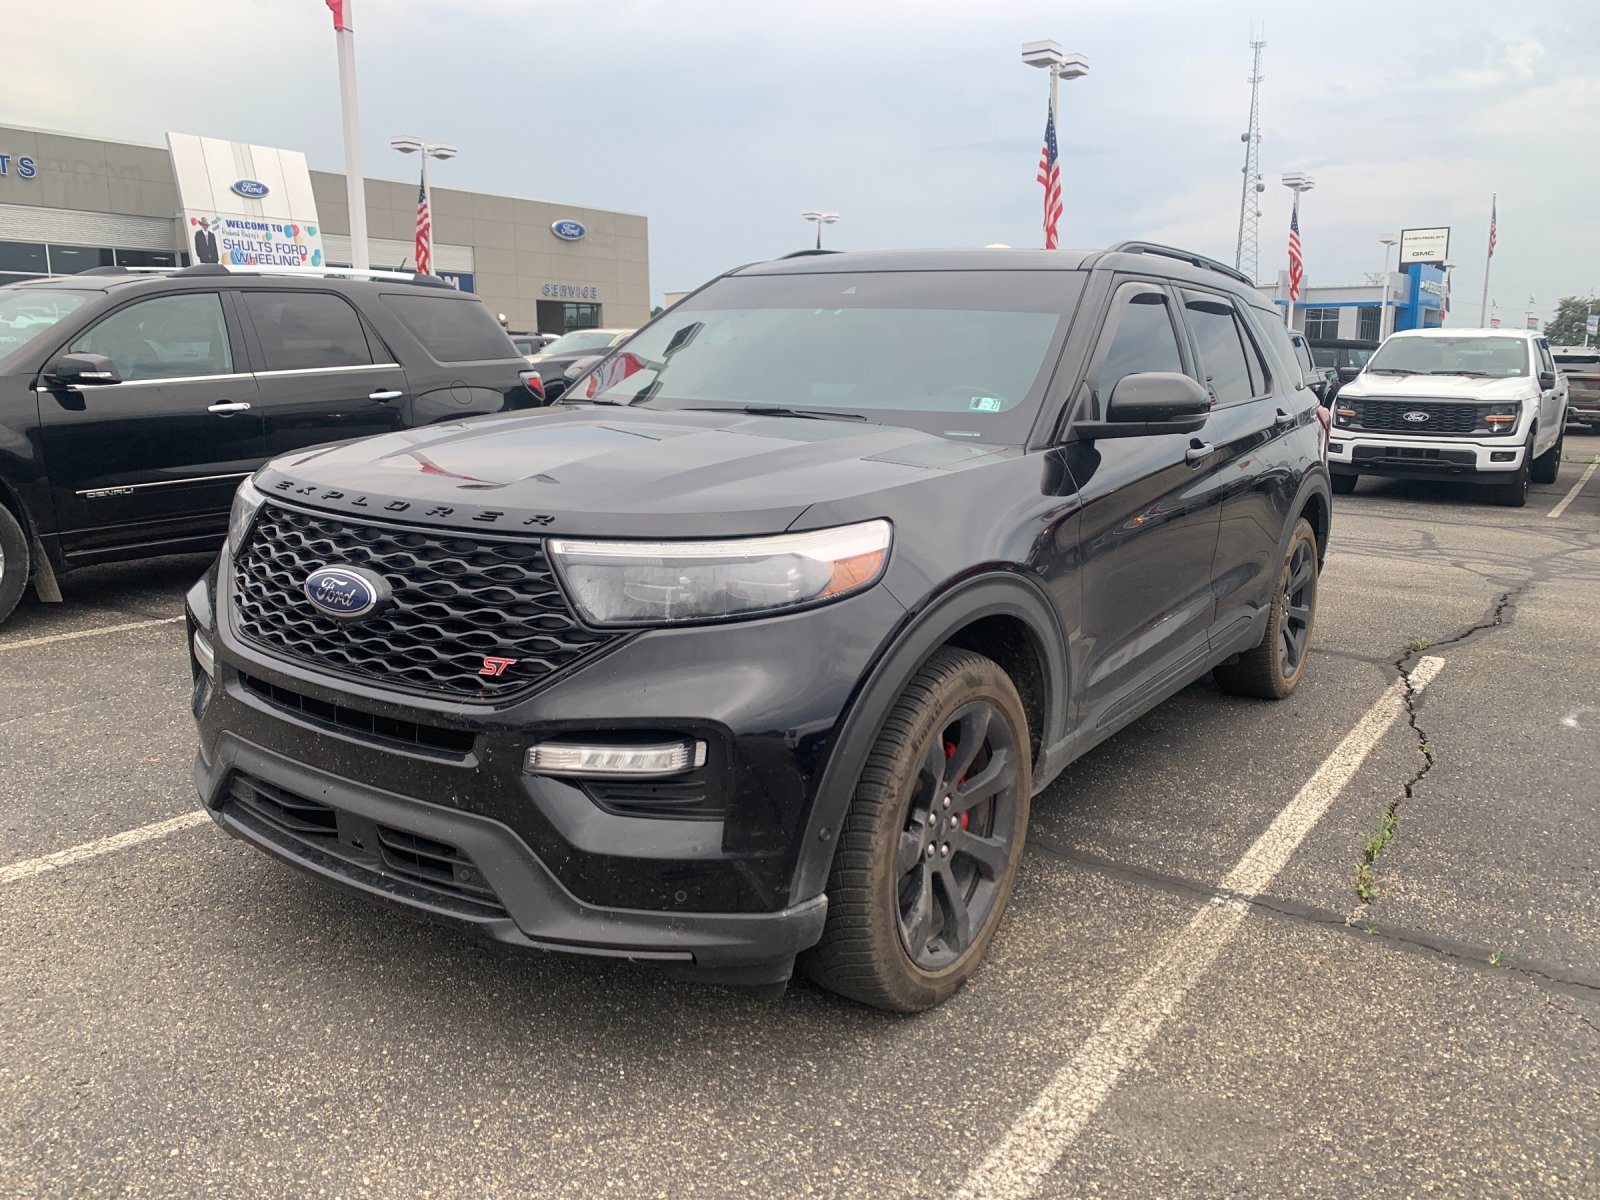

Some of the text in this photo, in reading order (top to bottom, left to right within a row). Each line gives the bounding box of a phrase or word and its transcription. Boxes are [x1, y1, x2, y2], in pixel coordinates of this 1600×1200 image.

[241, 182, 263, 194] Ford
[225, 219, 269, 232] WELCOME
[271, 223, 283, 233] TO
[561, 223, 581, 236] Ford
[223, 238, 308, 256] SHULTS FORD
[234, 250, 300, 266] WHEELING
[542, 283, 598, 298] SERVICE
[86, 487, 134, 498] DENALI
[274, 480, 556, 527] EXPLORER
[316, 577, 354, 607] Ford
[478, 656, 518, 676] ST
